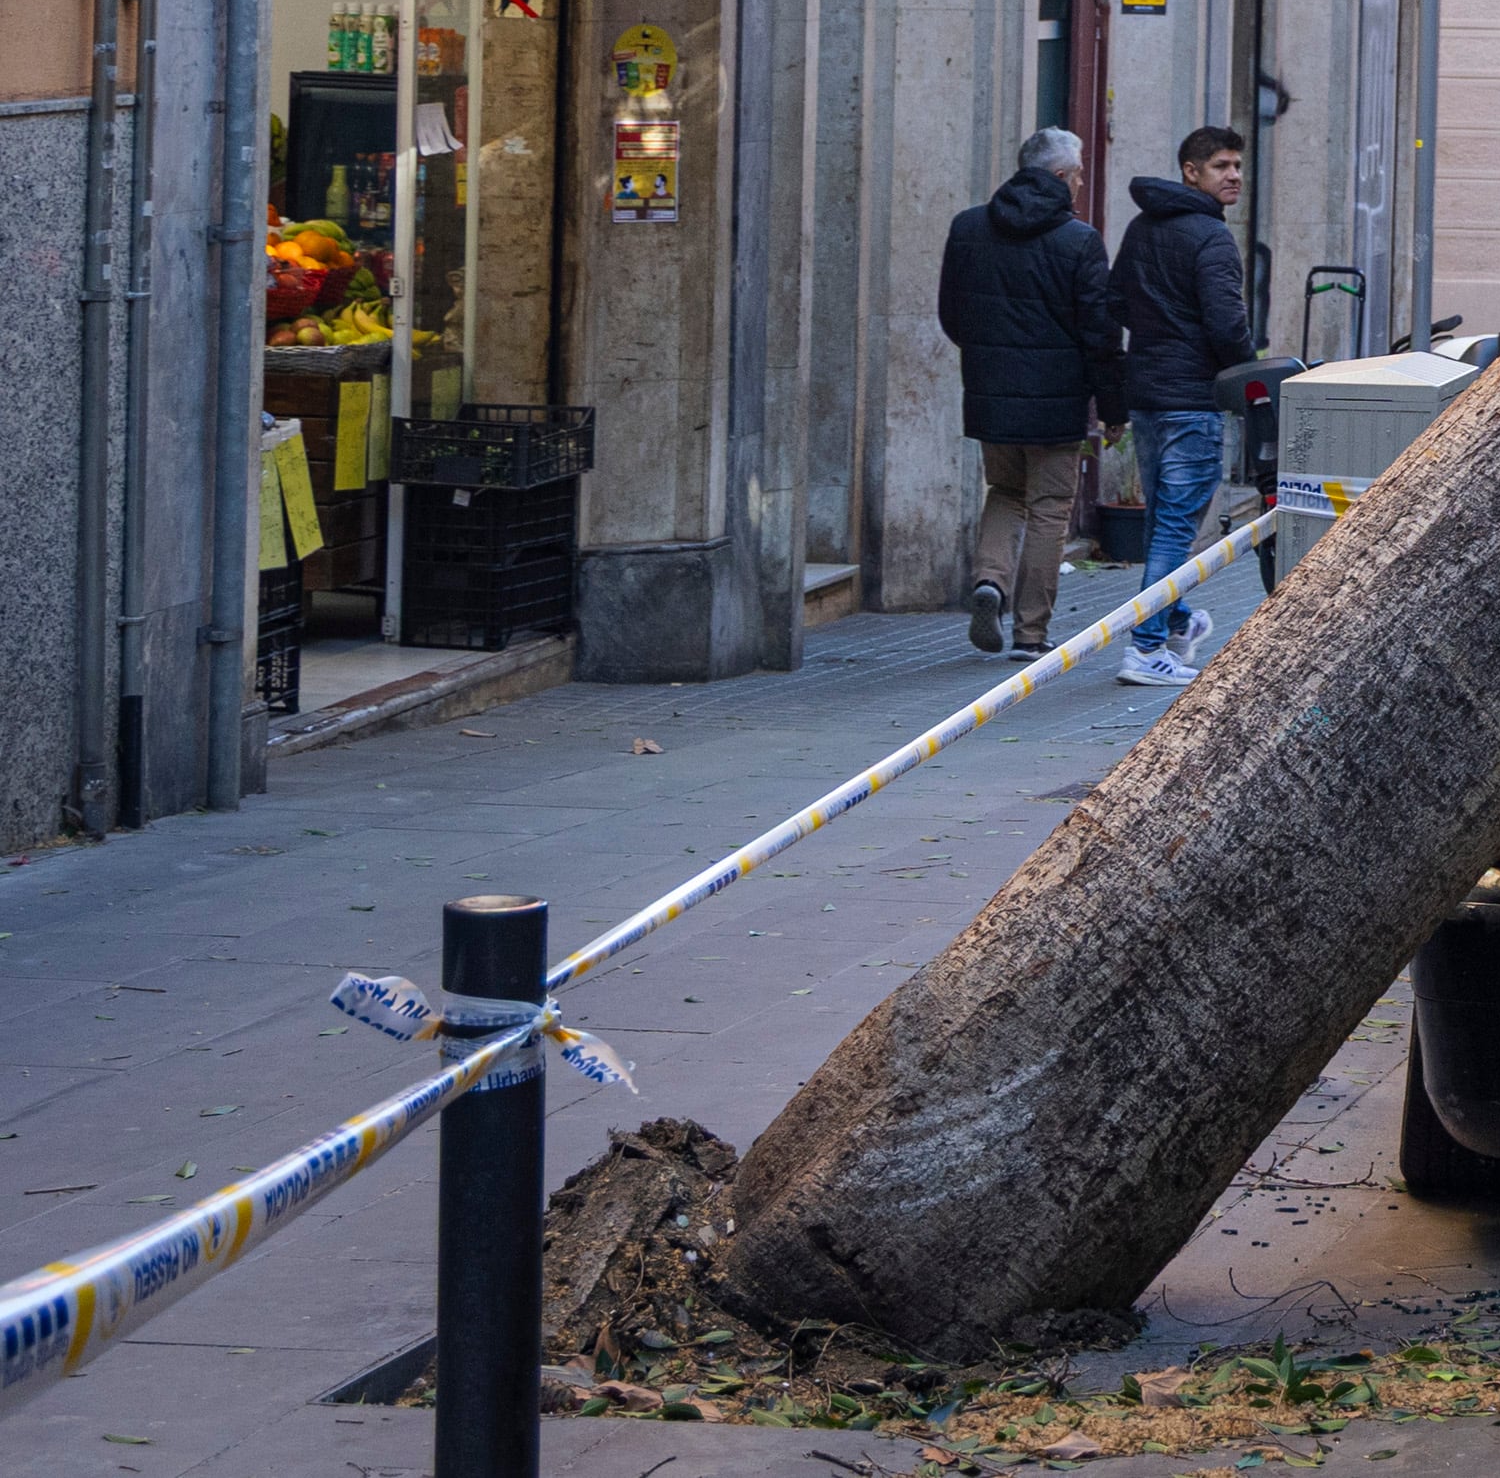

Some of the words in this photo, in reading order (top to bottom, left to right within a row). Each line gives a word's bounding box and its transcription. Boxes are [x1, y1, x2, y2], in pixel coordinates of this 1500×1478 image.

[263, 1167, 311, 1225] POLICIA
[133, 1244, 180, 1305] PASSEU
[181, 1230, 200, 1274] NO
